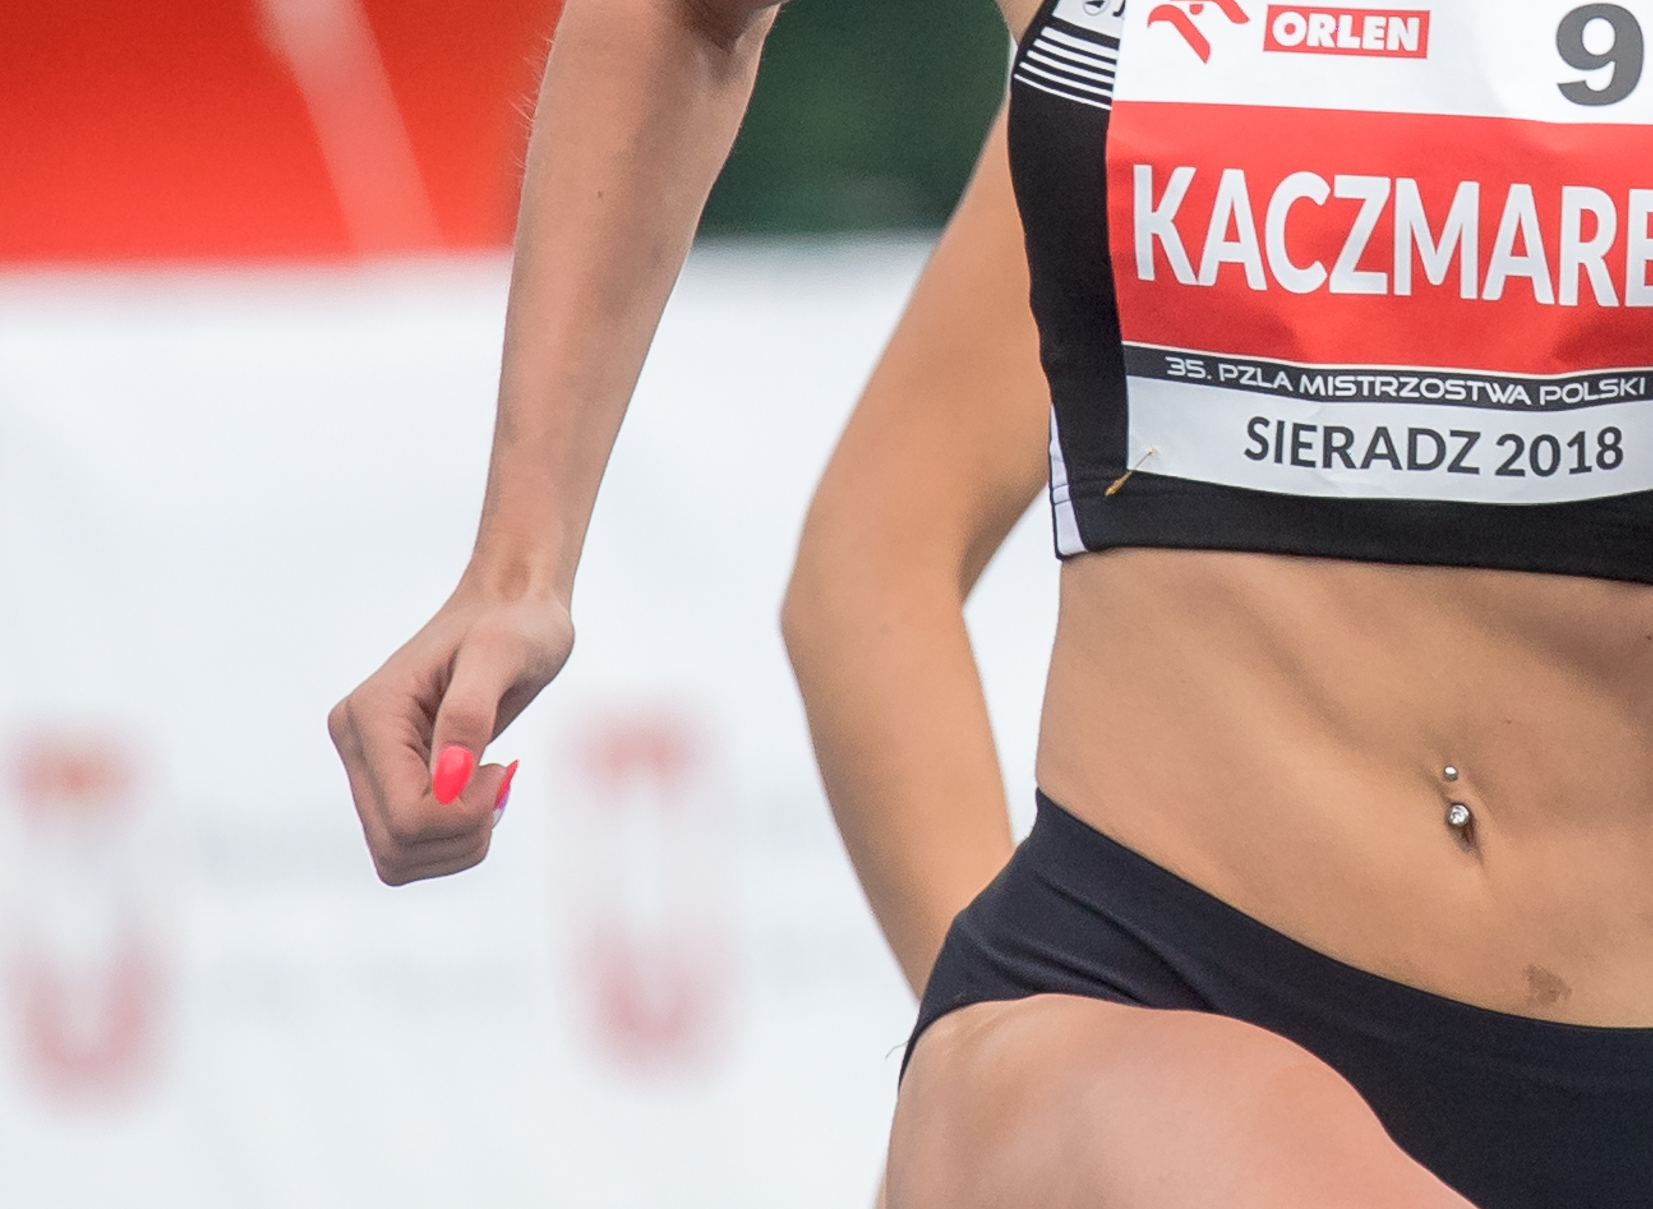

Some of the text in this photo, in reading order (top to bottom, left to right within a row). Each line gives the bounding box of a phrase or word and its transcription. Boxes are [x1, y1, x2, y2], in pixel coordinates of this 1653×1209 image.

[1271, 10, 1421, 53] ORLEN
[1555, 3, 1645, 106] 9
[1165, 356, 1212, 380] 35.
[1218, 363, 1294, 391] PZLA
[1299, 374, 1531, 405] MISTRZOSTWA
[1540, 377, 1645, 405] POLSKI
[1243, 415, 1624, 478] SIERADZ 2018
